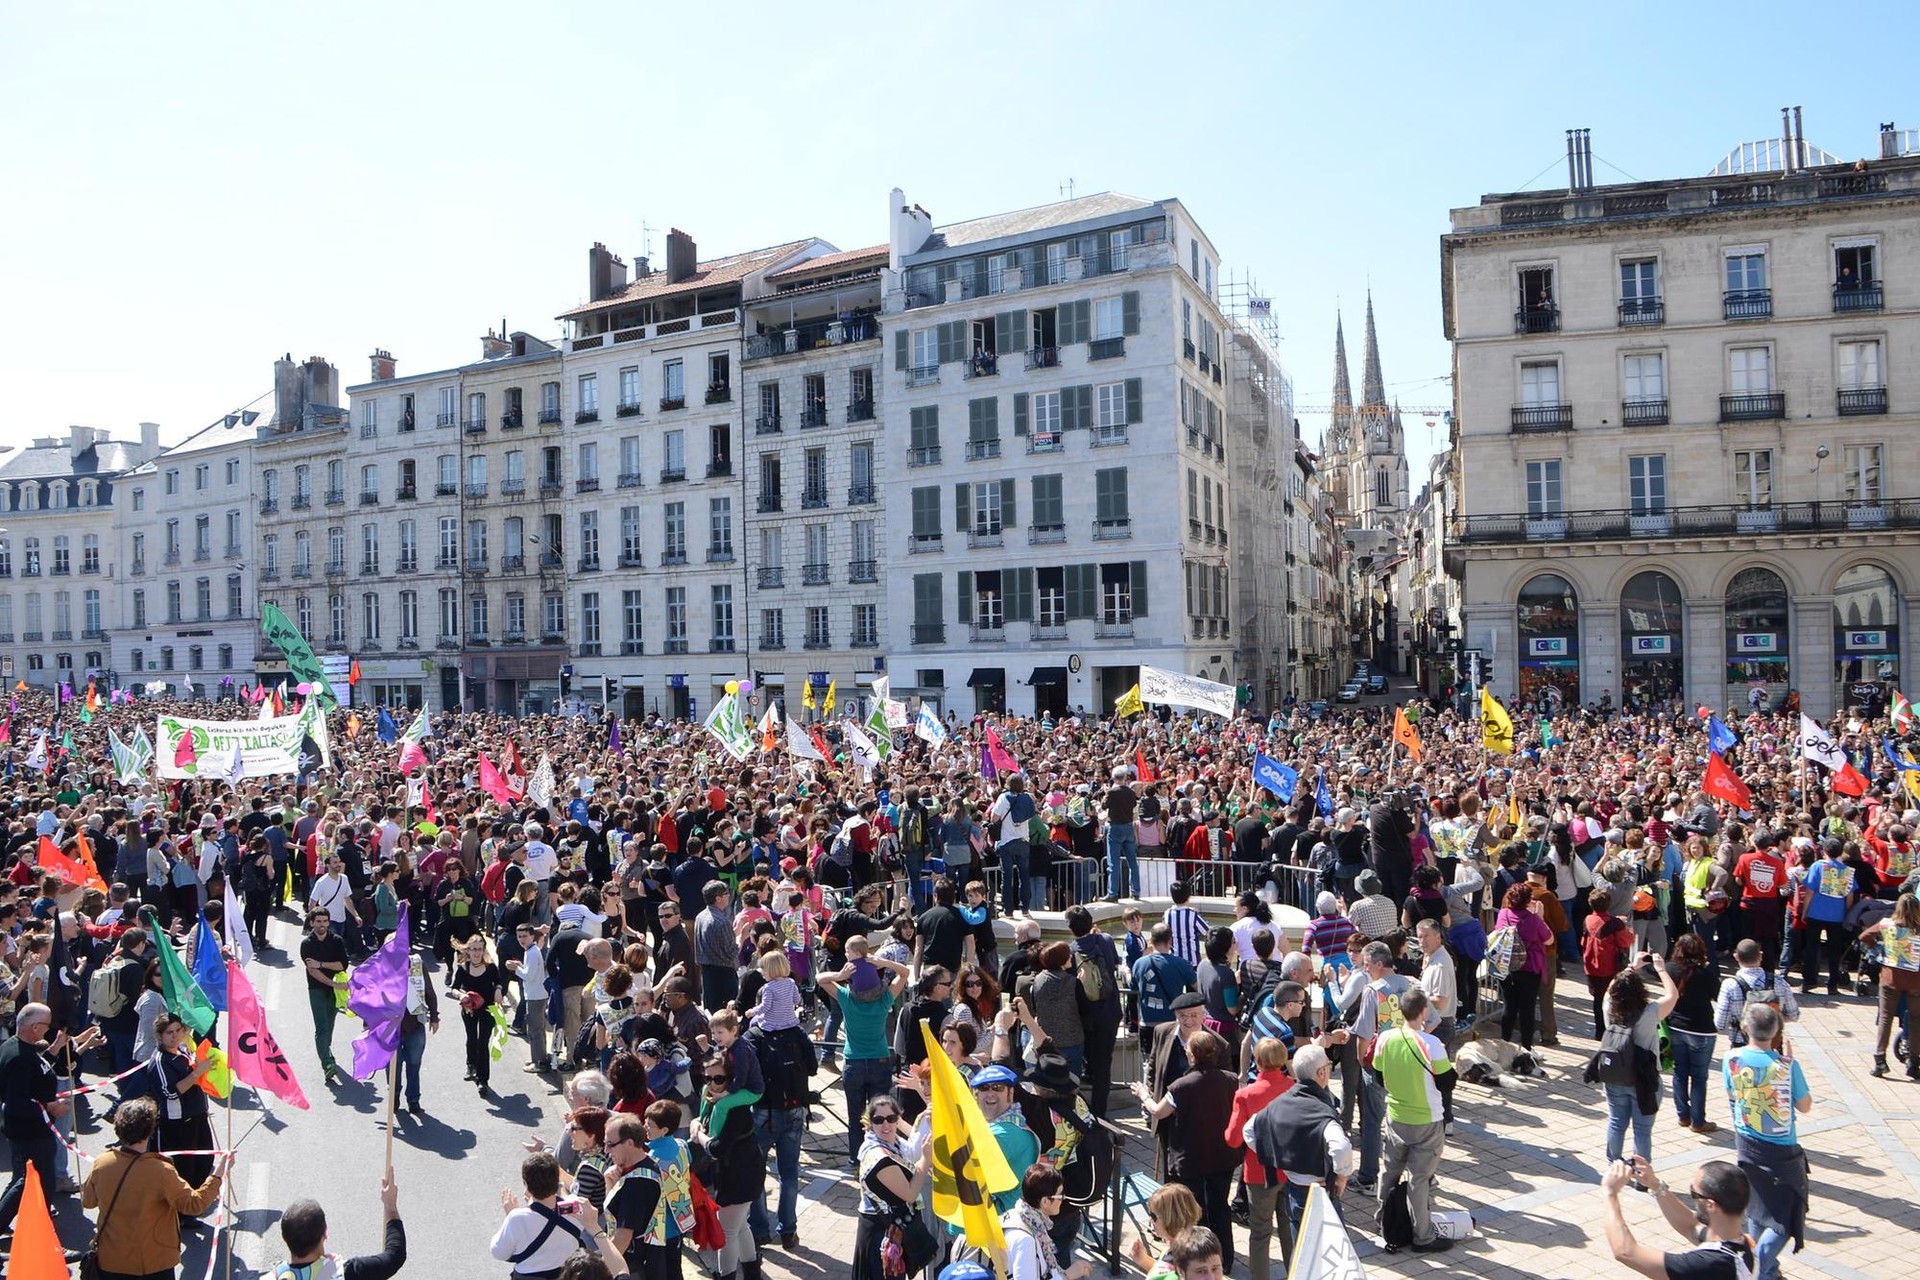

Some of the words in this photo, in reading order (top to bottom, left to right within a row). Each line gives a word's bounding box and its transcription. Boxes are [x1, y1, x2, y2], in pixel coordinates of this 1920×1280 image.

[1250, 300, 1270, 309] BAB
[1805, 735, 1839, 760] aek
[1260, 765, 1289, 790] aek
